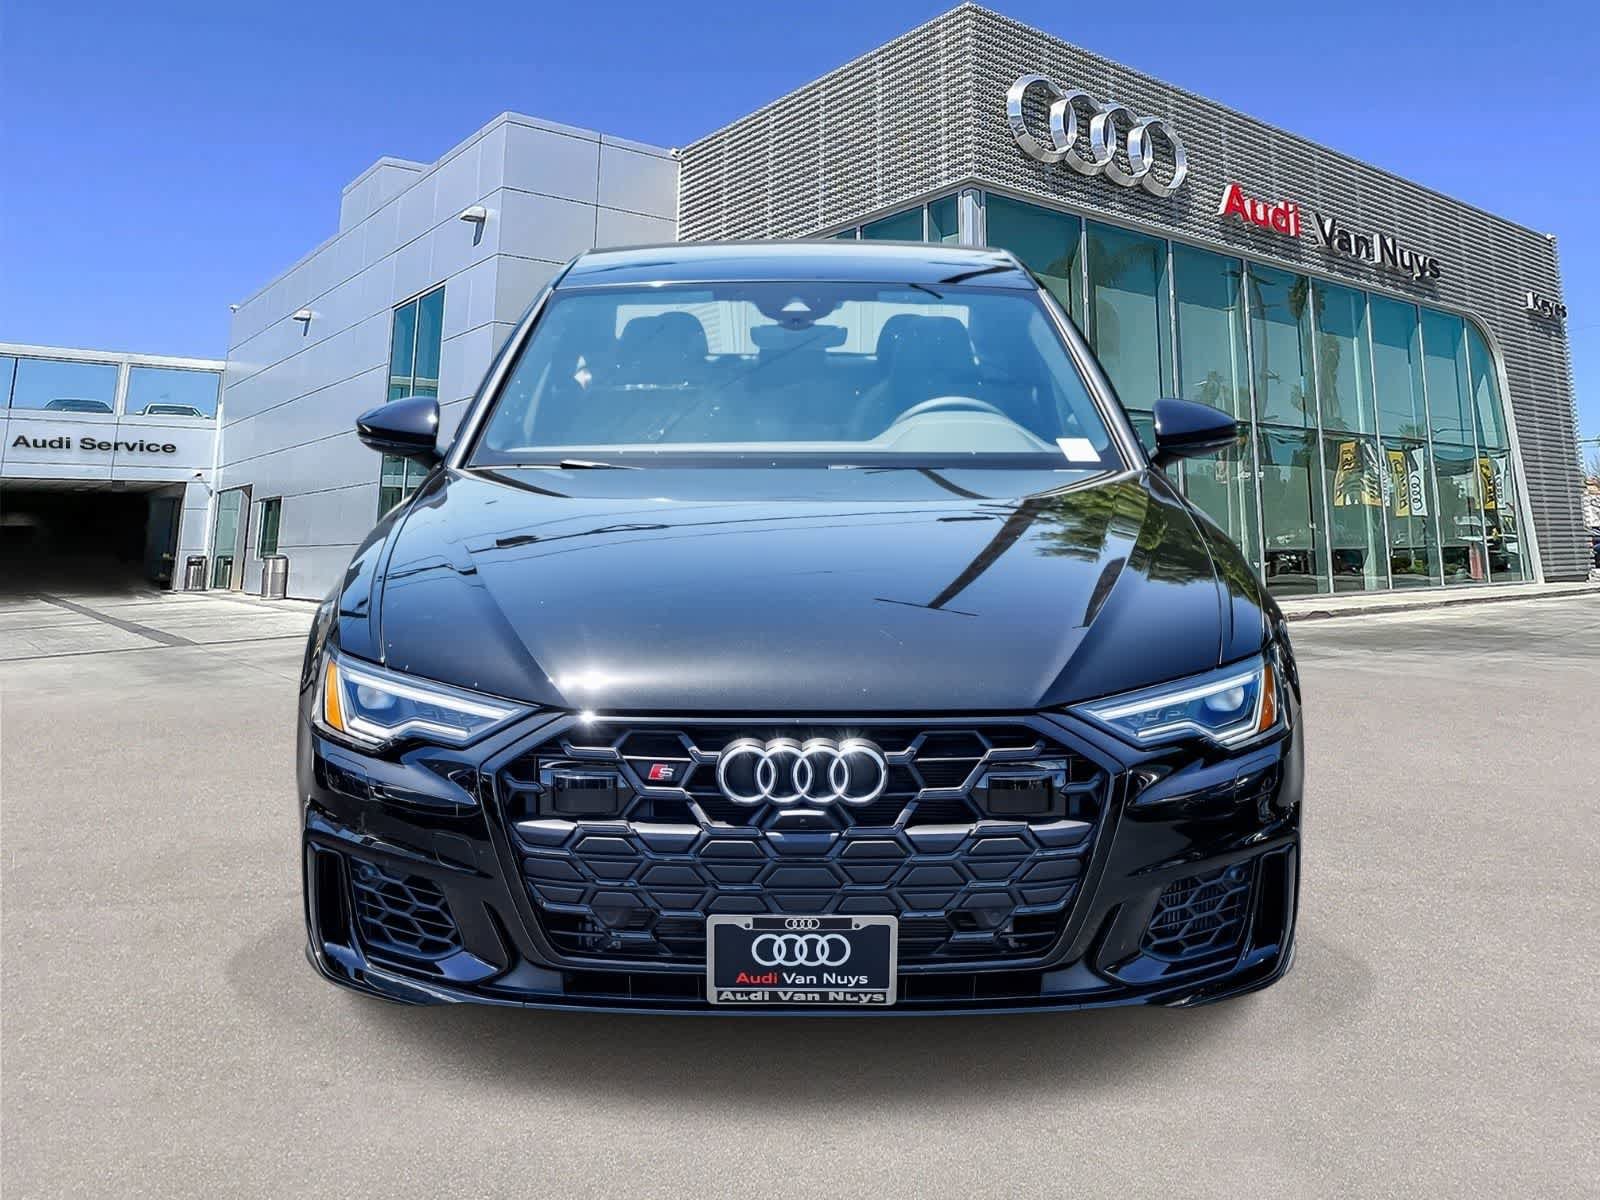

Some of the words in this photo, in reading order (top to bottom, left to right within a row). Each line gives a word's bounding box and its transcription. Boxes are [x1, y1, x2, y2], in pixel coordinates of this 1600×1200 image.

[1218, 183, 1302, 238] Audi
[1311, 211, 1371, 259] Van
[1373, 233, 1441, 280] Nuys
[1527, 292, 1567, 319] Keyes
[12, 435, 71, 449] Audi
[80, 437, 177, 454] Service
[736, 972, 778, 984] Audi
[782, 973, 817, 985] Van
[823, 973, 868, 987] Nuys
[719, 991, 770, 1001] Audi
[777, 991, 820, 1001] Van
[828, 991, 885, 1003] Nuys
